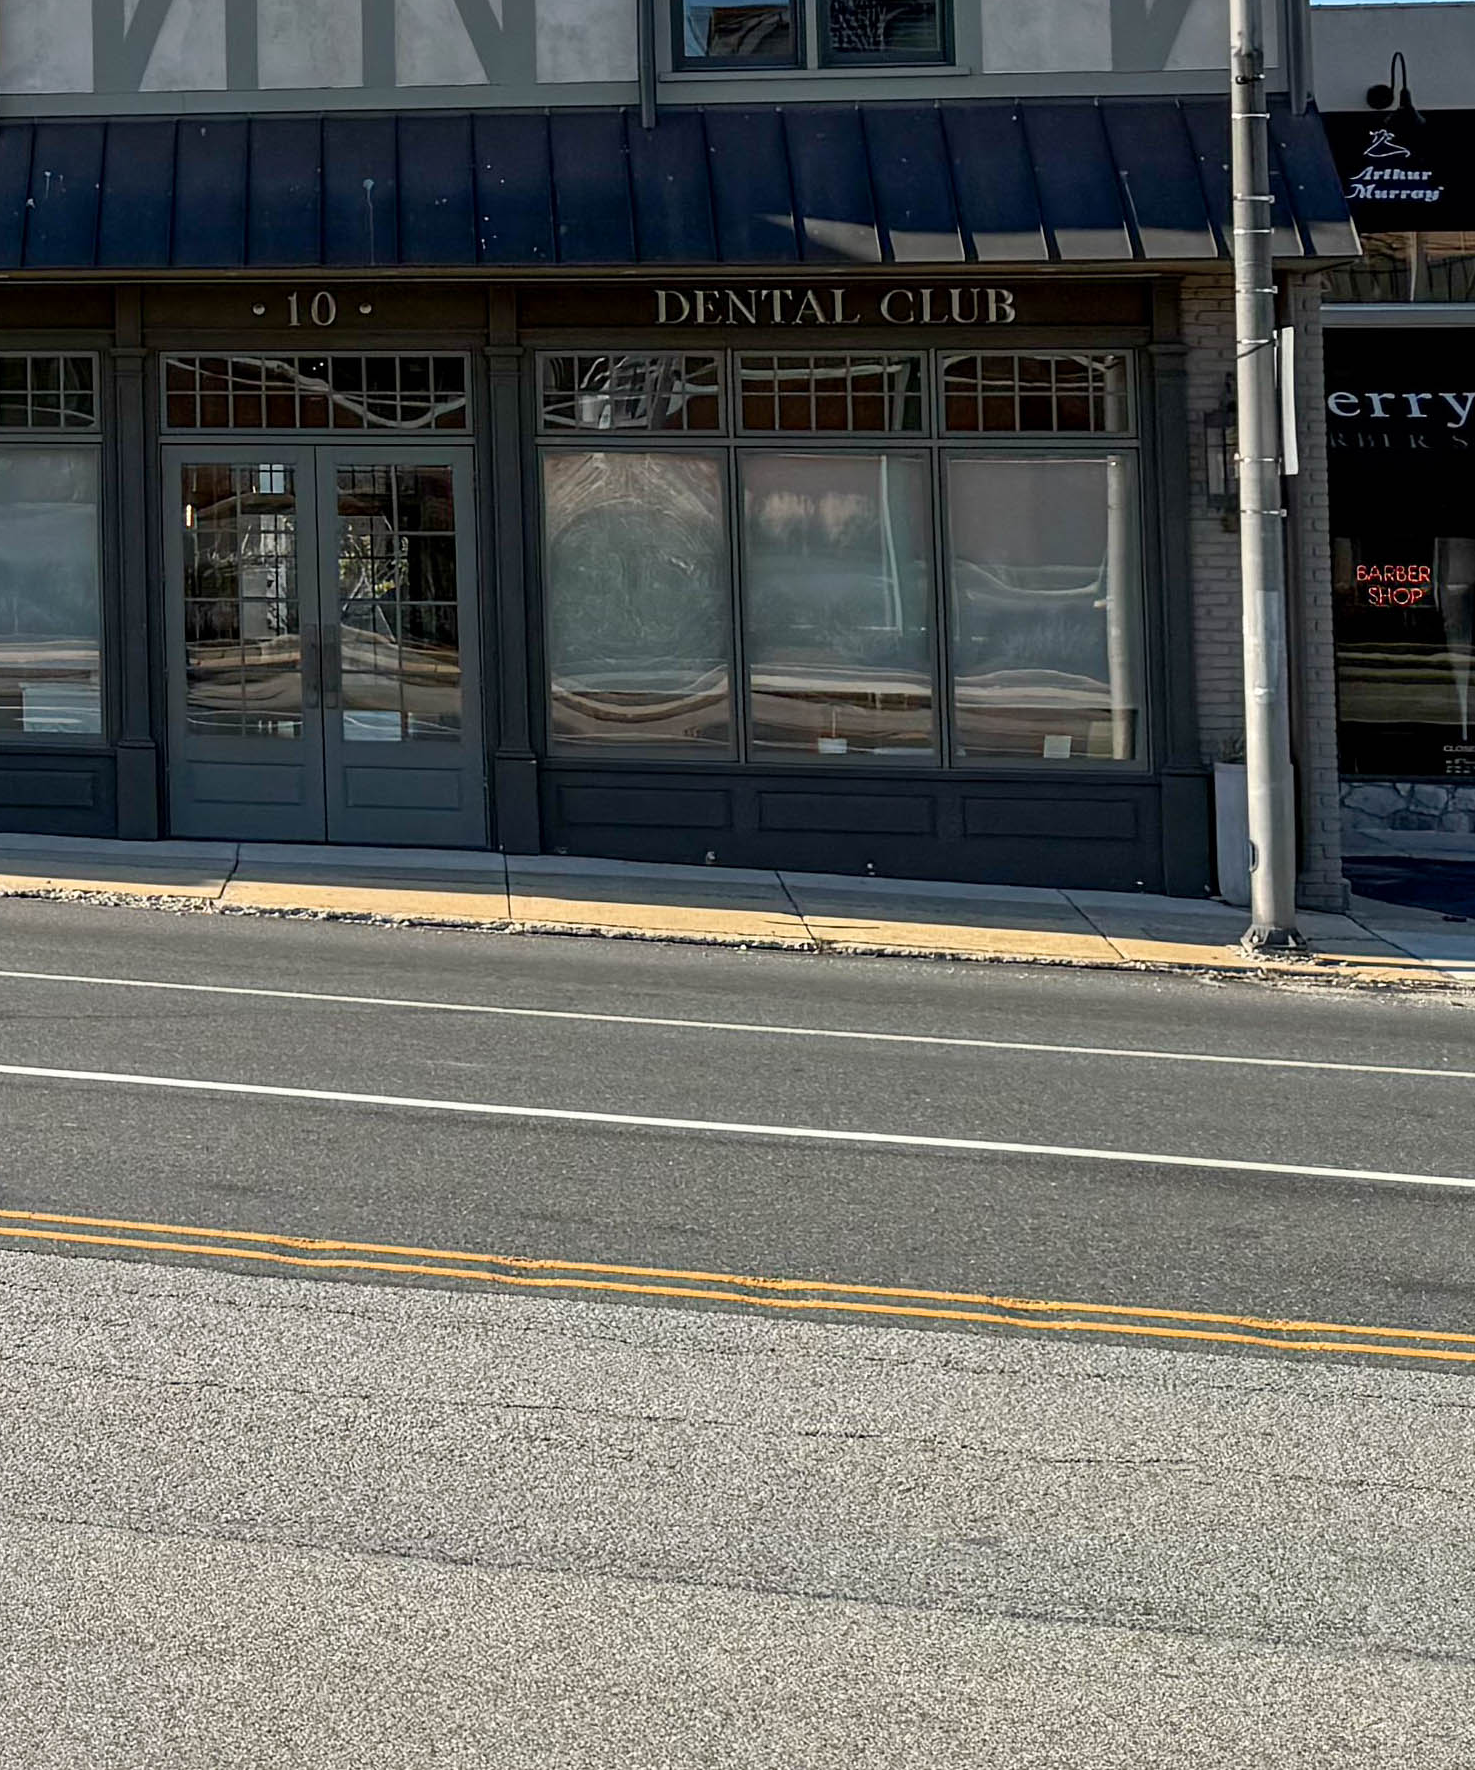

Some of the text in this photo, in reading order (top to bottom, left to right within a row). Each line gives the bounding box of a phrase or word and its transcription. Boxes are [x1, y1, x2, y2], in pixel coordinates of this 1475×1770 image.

[1349, 166, 1432, 180] Arthur
[1344, 184, 1440, 202] Murray
[287, 291, 337, 327] 10
[654, 288, 1016, 325] DENTAL CLUB
[1356, 565, 1431, 582] BARBER
[1368, 587, 1424, 605] SHOP
